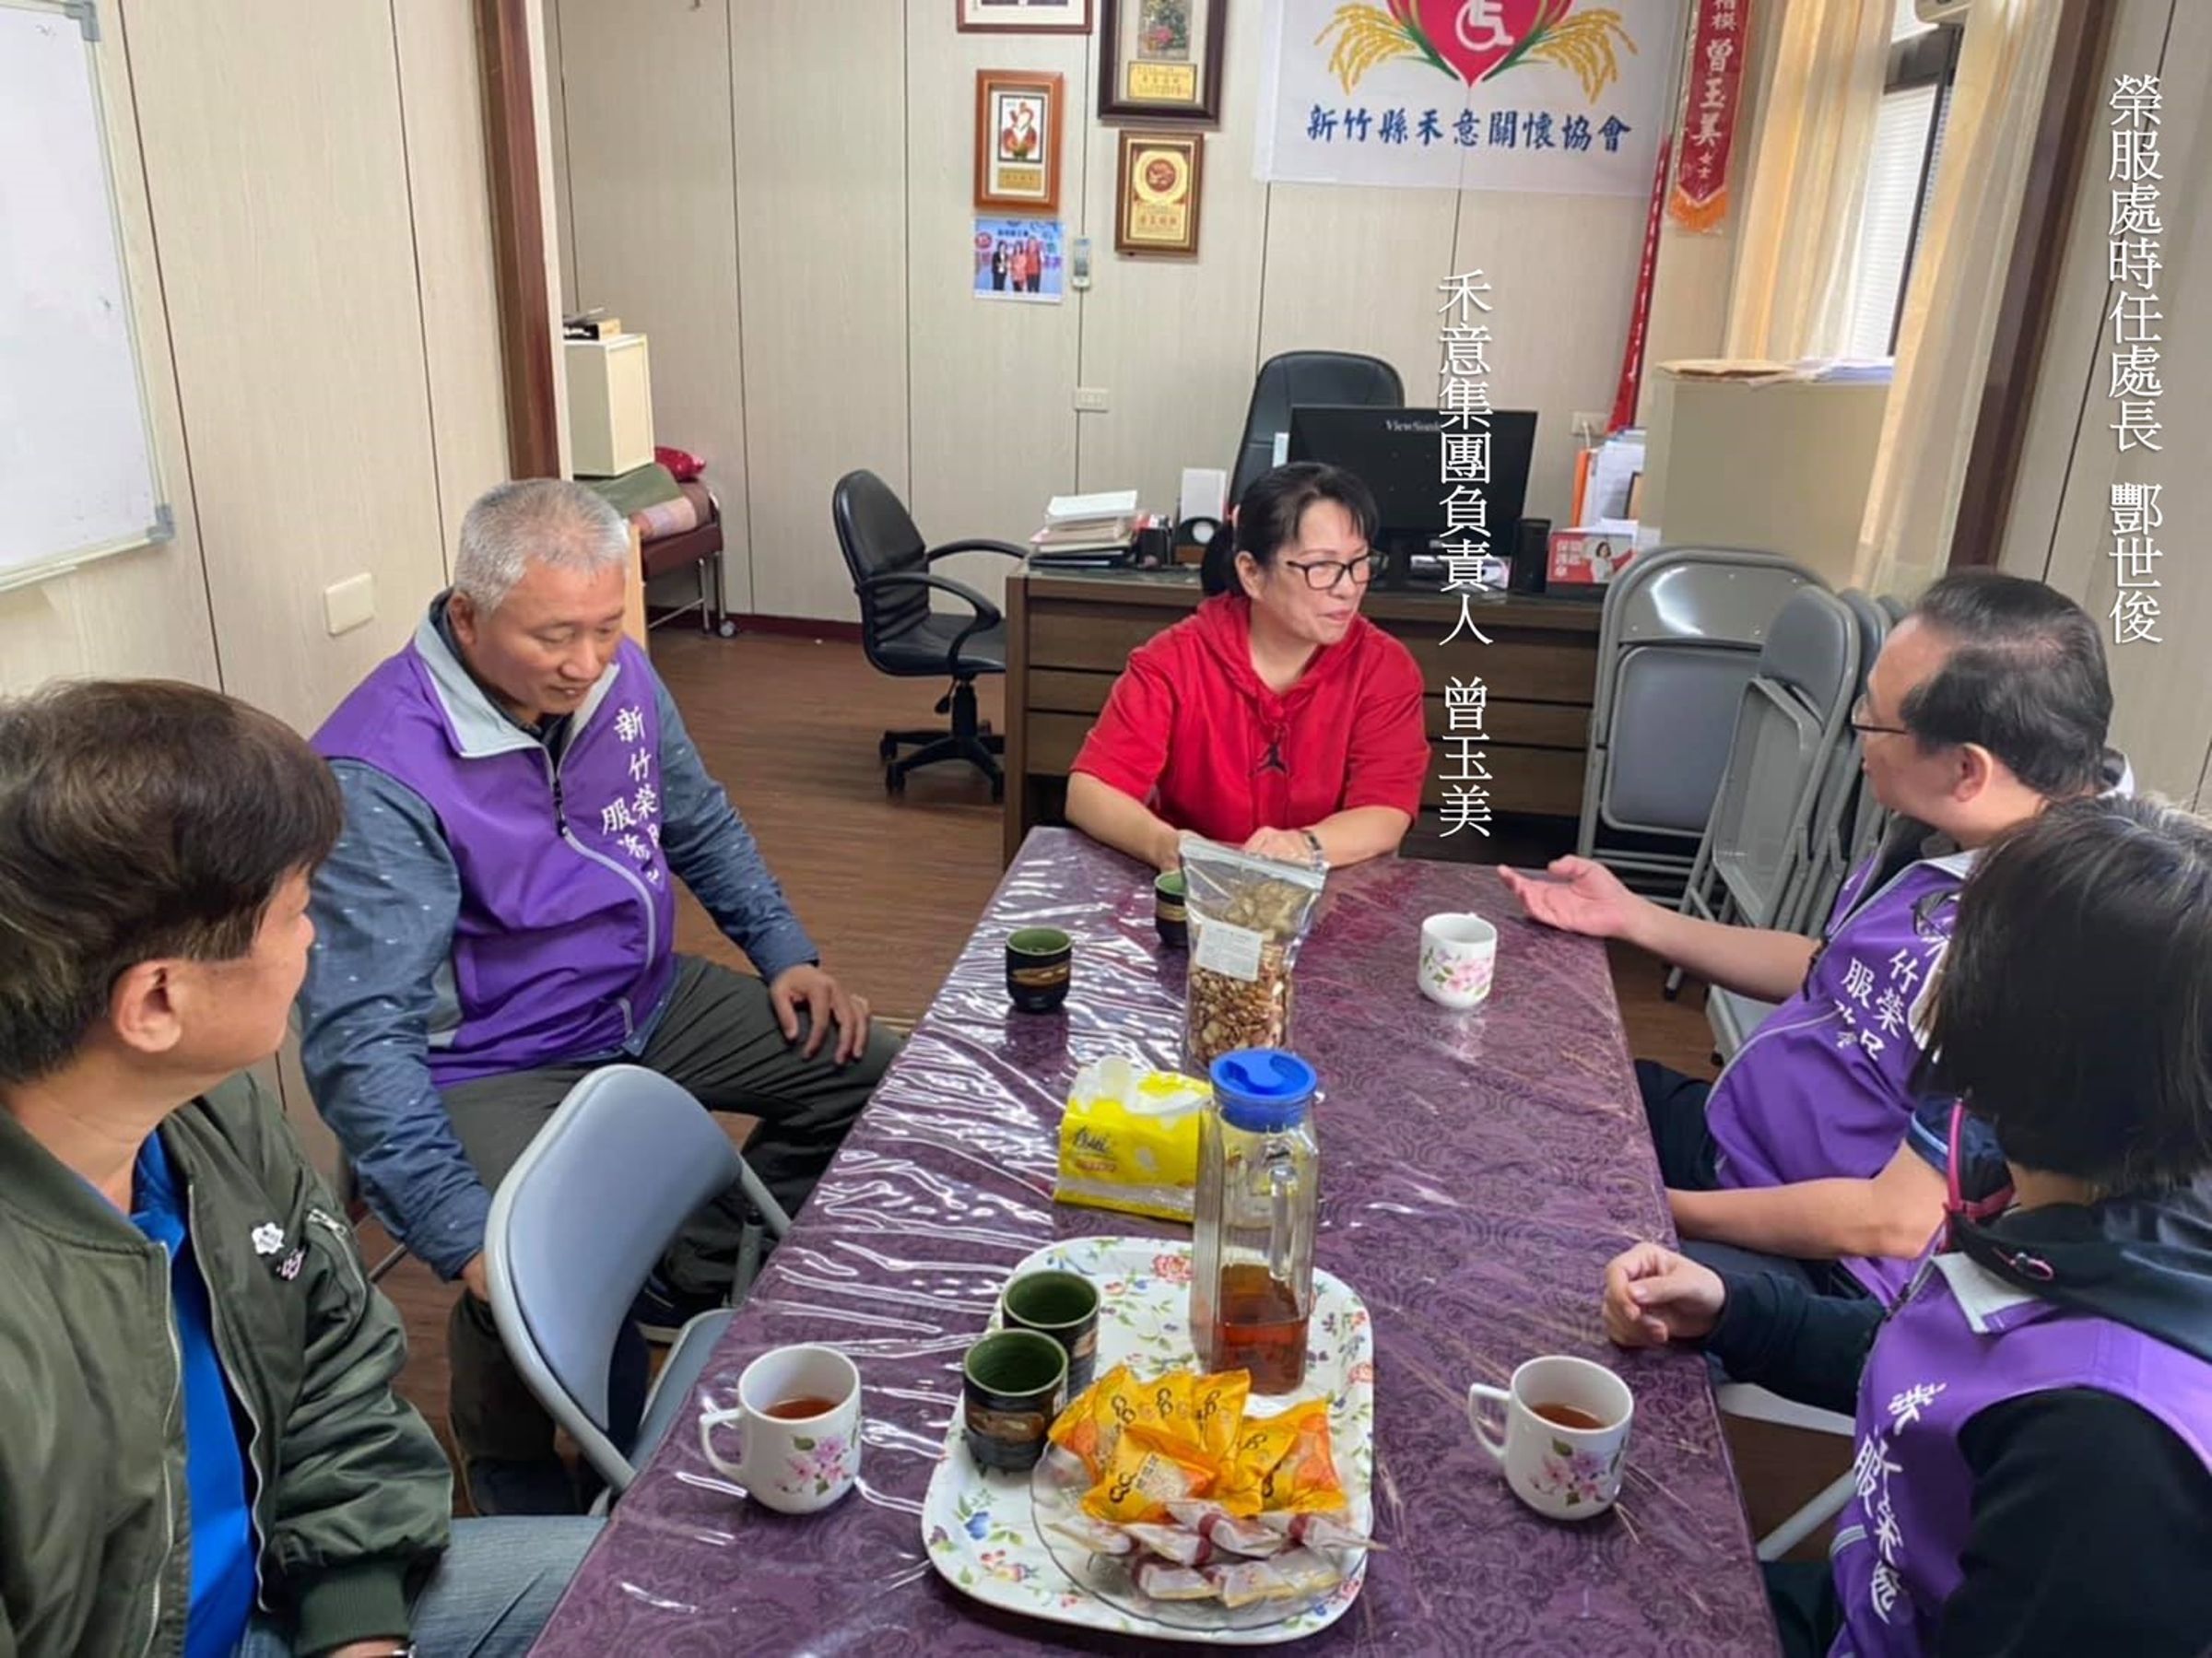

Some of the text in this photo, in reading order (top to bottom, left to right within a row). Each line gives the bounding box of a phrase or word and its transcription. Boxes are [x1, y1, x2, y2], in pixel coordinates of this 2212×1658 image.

[1307, 104, 1632, 151] 新竹縣禾意關懷協會
